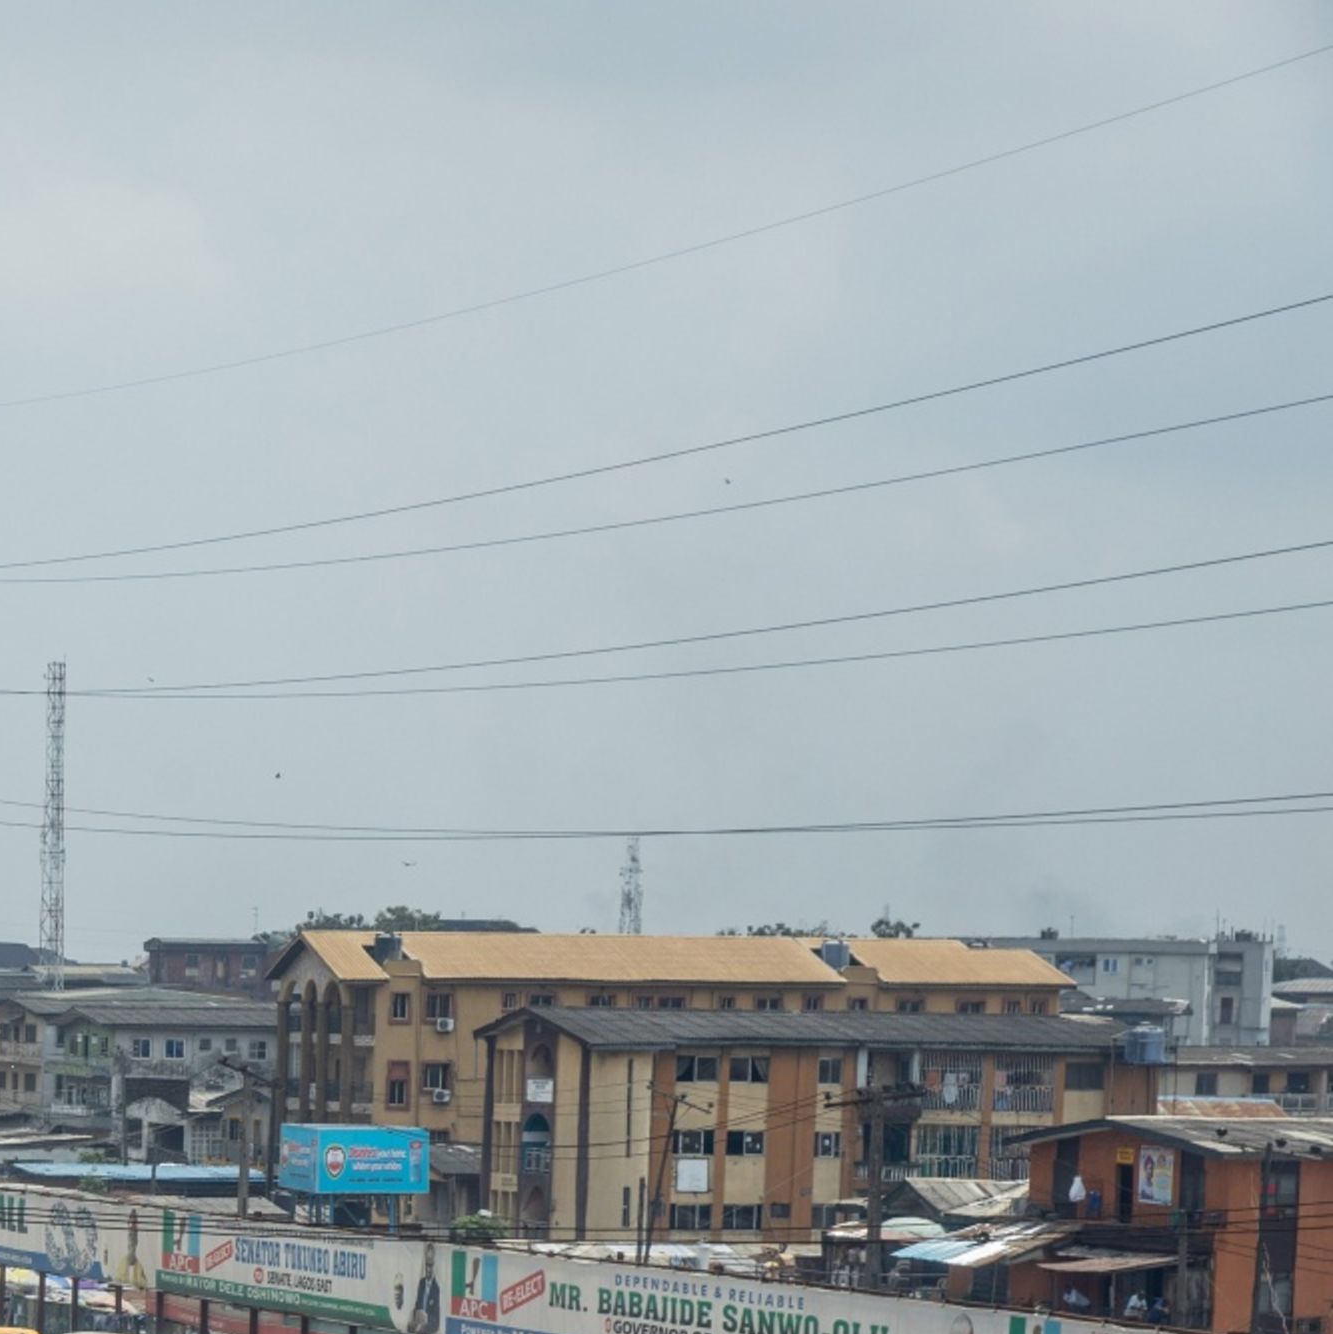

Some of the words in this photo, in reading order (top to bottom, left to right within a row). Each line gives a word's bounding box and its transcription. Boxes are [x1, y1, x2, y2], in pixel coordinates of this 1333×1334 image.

[168, 1257, 193, 1273] APC
[235, 1237, 280, 1267] SENATOR
[333, 1250, 367, 1280] ABIRU
[219, 1281, 243, 1296] DELE
[247, 1287, 300, 1305] OSHINOWO
[502, 1274, 544, 1312] RE-ELECT
[549, 1282, 588, 1312] MR.
[597, 1288, 712, 1329] BABAJIDE
[615, 1274, 708, 1297] DEPENDABLE
[713, 1287, 722, 1299] &
[728, 1289, 805, 1310] RELIABLE
[459, 1304, 488, 1319] APC
